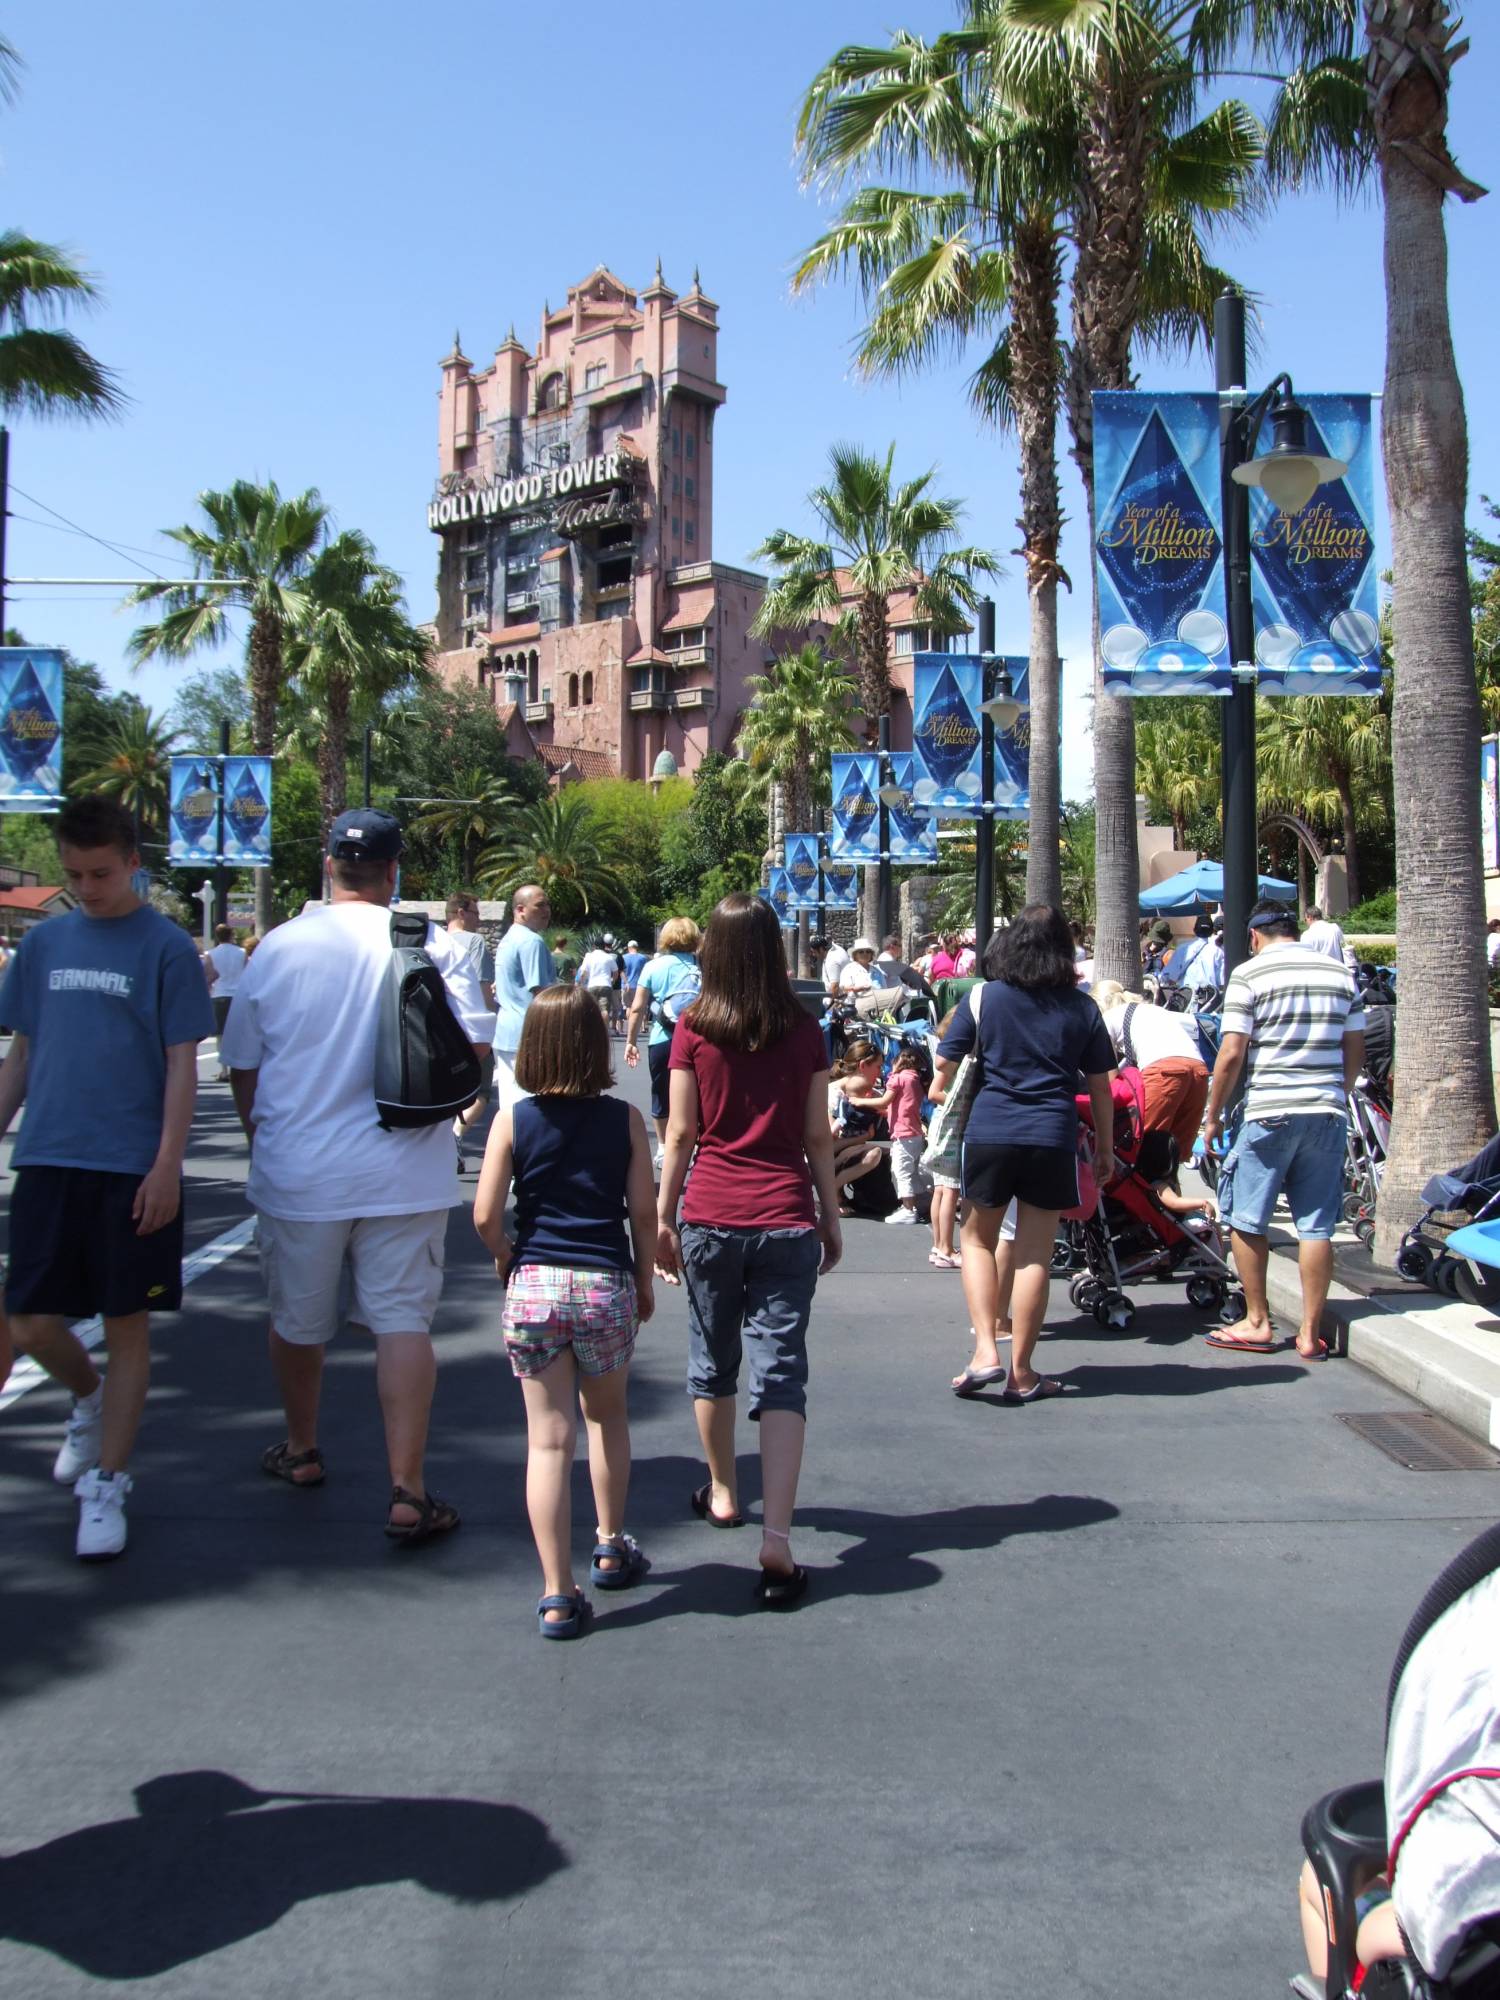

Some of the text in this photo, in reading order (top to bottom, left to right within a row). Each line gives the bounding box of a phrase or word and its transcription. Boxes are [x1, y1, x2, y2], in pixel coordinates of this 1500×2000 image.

[427, 453, 619, 528] HOLLYWOOD TOWER
[551, 488, 619, 532] Hotel
[1124, 501, 1180, 526] Year of a
[1308, 501, 1326, 526] of
[1323, 507, 1332, 518] a
[1100, 518, 1214, 547] Million
[1254, 518, 1367, 547] Million
[1136, 545, 1211, 564] DREAMS
[1289, 545, 1363, 564] DREAMS
[915, 720, 978, 737] Million
[934, 736, 975, 746] DREAMS
